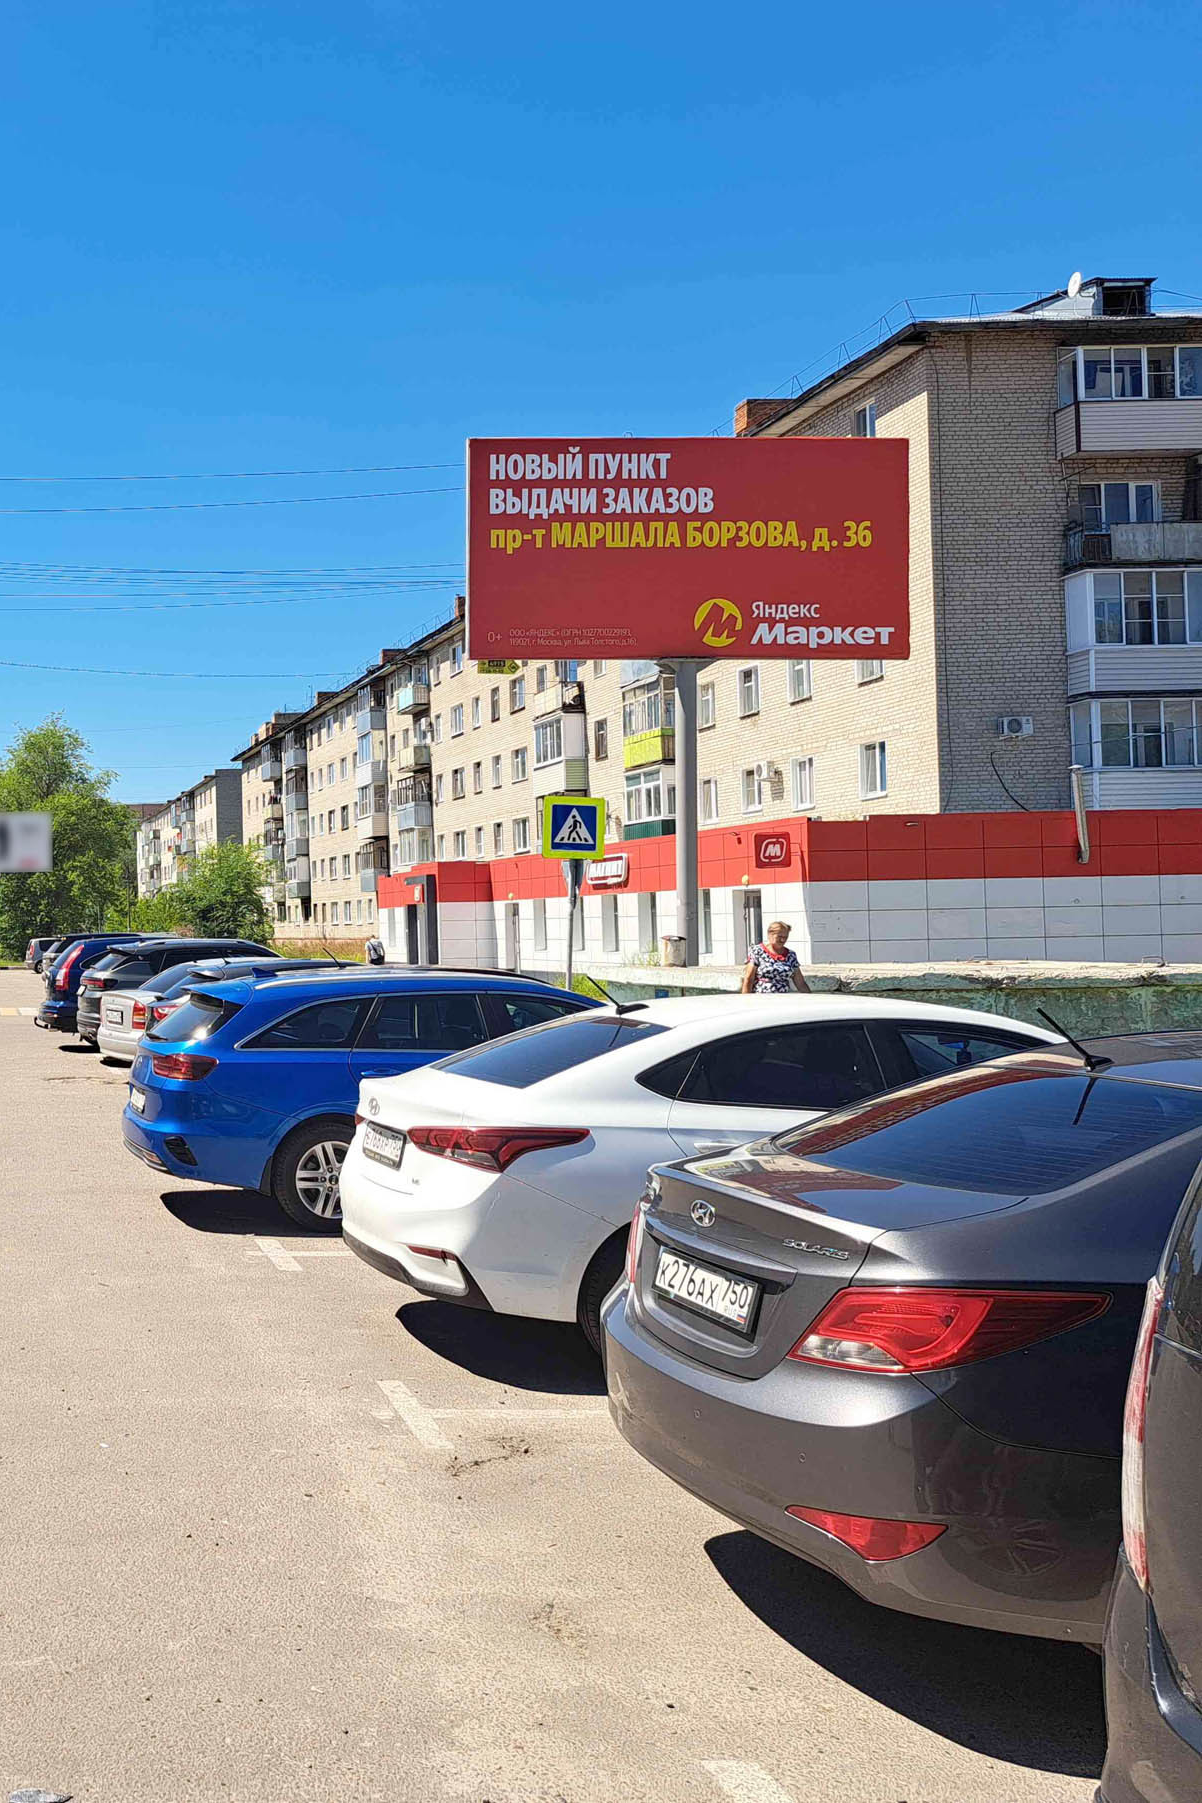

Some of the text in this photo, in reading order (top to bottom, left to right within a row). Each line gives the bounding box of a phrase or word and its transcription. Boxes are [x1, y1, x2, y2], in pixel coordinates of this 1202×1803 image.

[489, 446, 671, 480] НОВЫЙ ПУНКТ
[489, 487, 714, 519] ВЫДАЧИ ЗАКАЗОВ
[490, 520, 872, 554] пр-т МАРШАЛА БОРЗОВА, д. 36
[751, 601, 820, 620] Яндекс
[487, 631, 503, 643] 0+
[750, 622, 895, 649] Маркет
[659, 1258, 748, 1309] К276АХ 750
